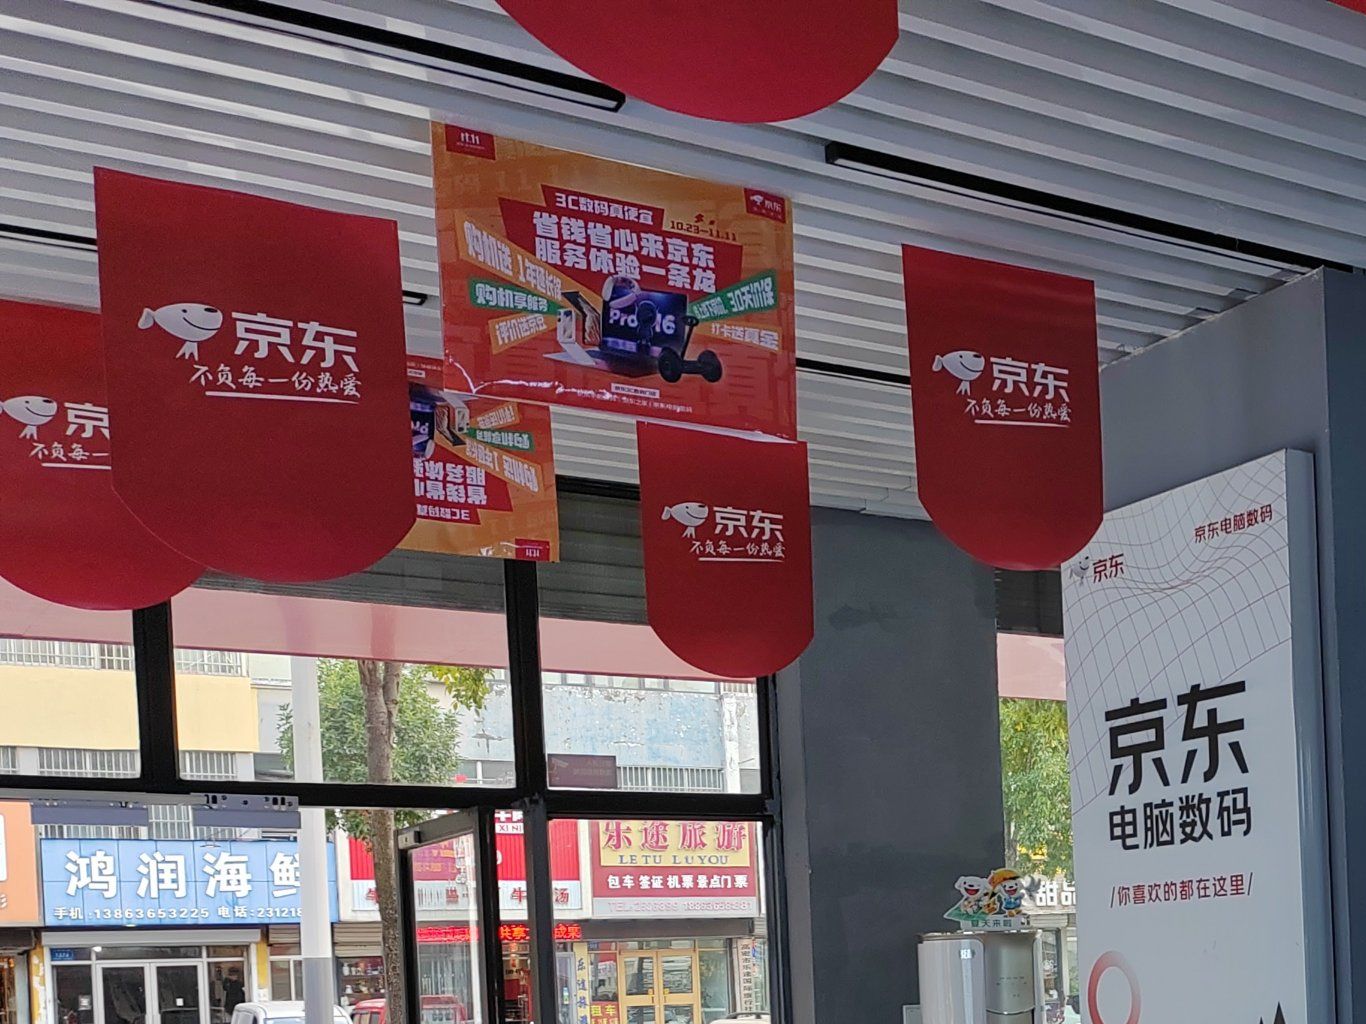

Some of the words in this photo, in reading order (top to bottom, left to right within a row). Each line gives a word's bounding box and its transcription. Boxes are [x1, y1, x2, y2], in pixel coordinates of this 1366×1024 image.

[555, 192, 655, 225] 3C数码真便宜
[533, 211, 716, 268] 省钱省心来京东
[535, 237, 717, 293] 服务体验一条龙
[608, 310, 638, 329] Pro
[231, 310, 360, 373] 京东
[189, 363, 362, 399] 不负每一份热爱
[990, 355, 1070, 402] 京东
[64, 402, 109, 438] 京
[966, 398, 1072, 423] 不负每一份热爱
[29, 442, 109, 461] 不负每一
[713, 504, 784, 542] 京东
[1194, 503, 1274, 544] 京东电脑数码
[690, 540, 786, 559] 不负每一份热爱
[1092, 553, 1126, 583] 京东
[1104, 680, 1250, 796] 京东
[602, 820, 748, 851] 乐途旅游
[1107, 786, 1253, 851] 电脑数码
[64, 849, 301, 899] 鸿润海鲜
[607, 874, 635, 889] 包车
[639, 874, 665, 889] 签证
[667, 874, 694, 889] 机票
[697, 874, 749, 889] 景点门票
[217, 906, 302, 920] 电话:231218
[499, 924, 582, 941] 共享成果
